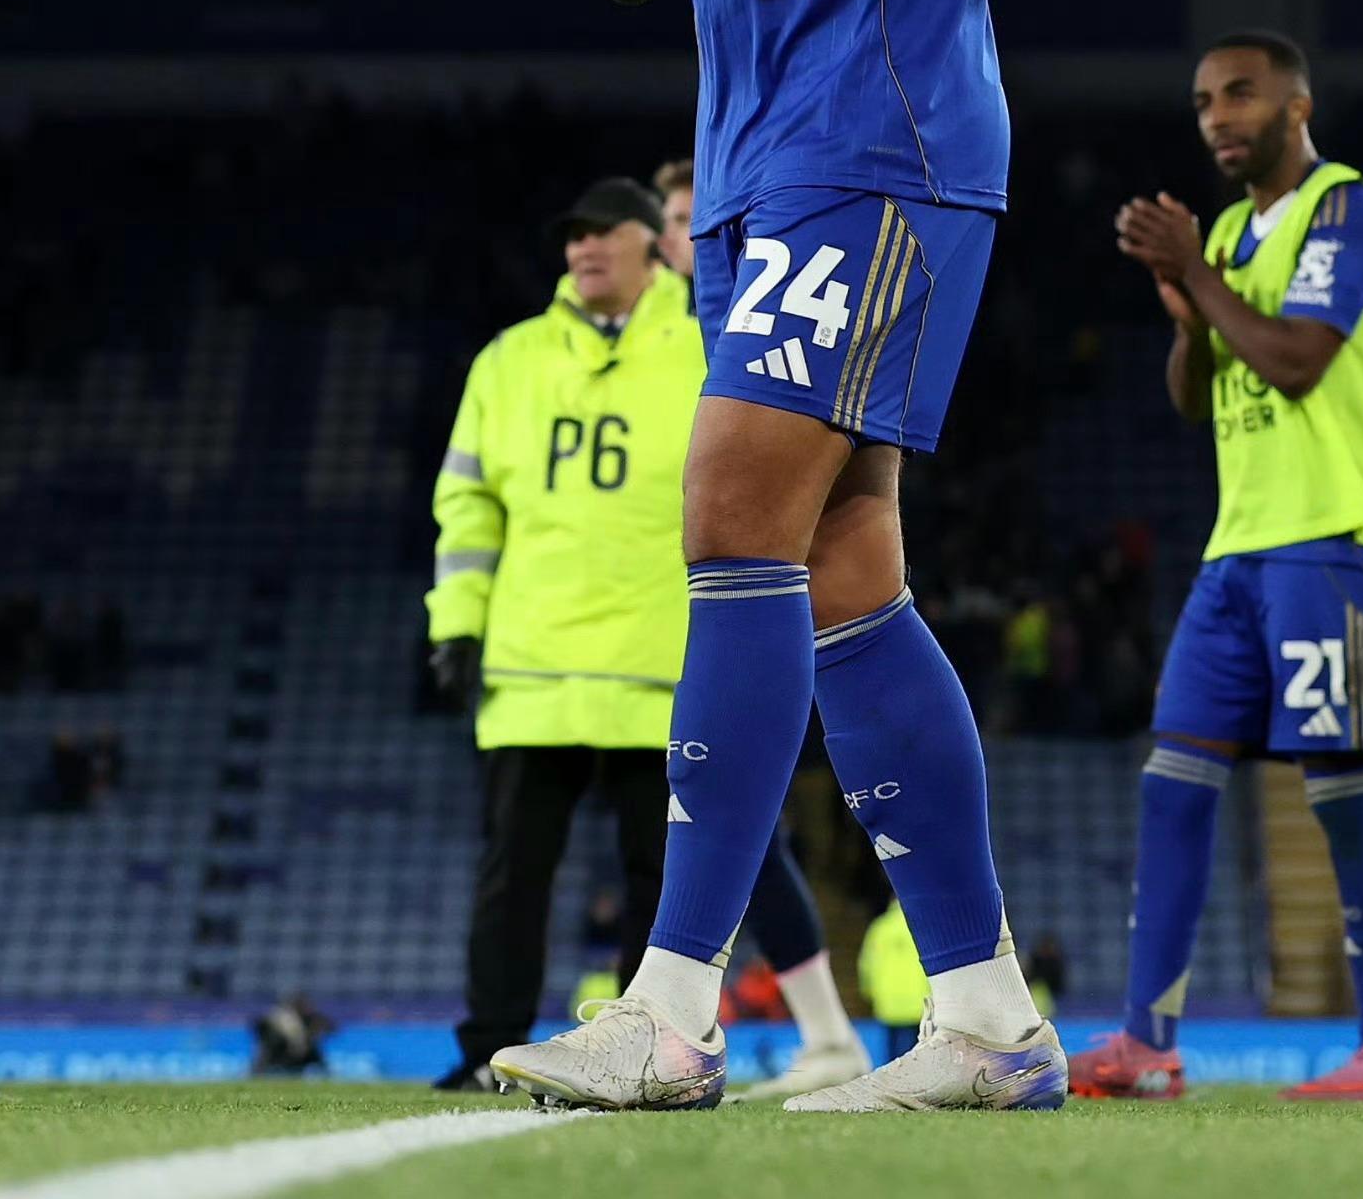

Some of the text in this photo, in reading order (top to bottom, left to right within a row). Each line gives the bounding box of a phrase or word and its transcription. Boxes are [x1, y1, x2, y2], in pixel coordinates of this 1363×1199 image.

[725, 238, 850, 349] 24
[546, 414, 629, 491] P6
[1280, 638, 1348, 709] 21
